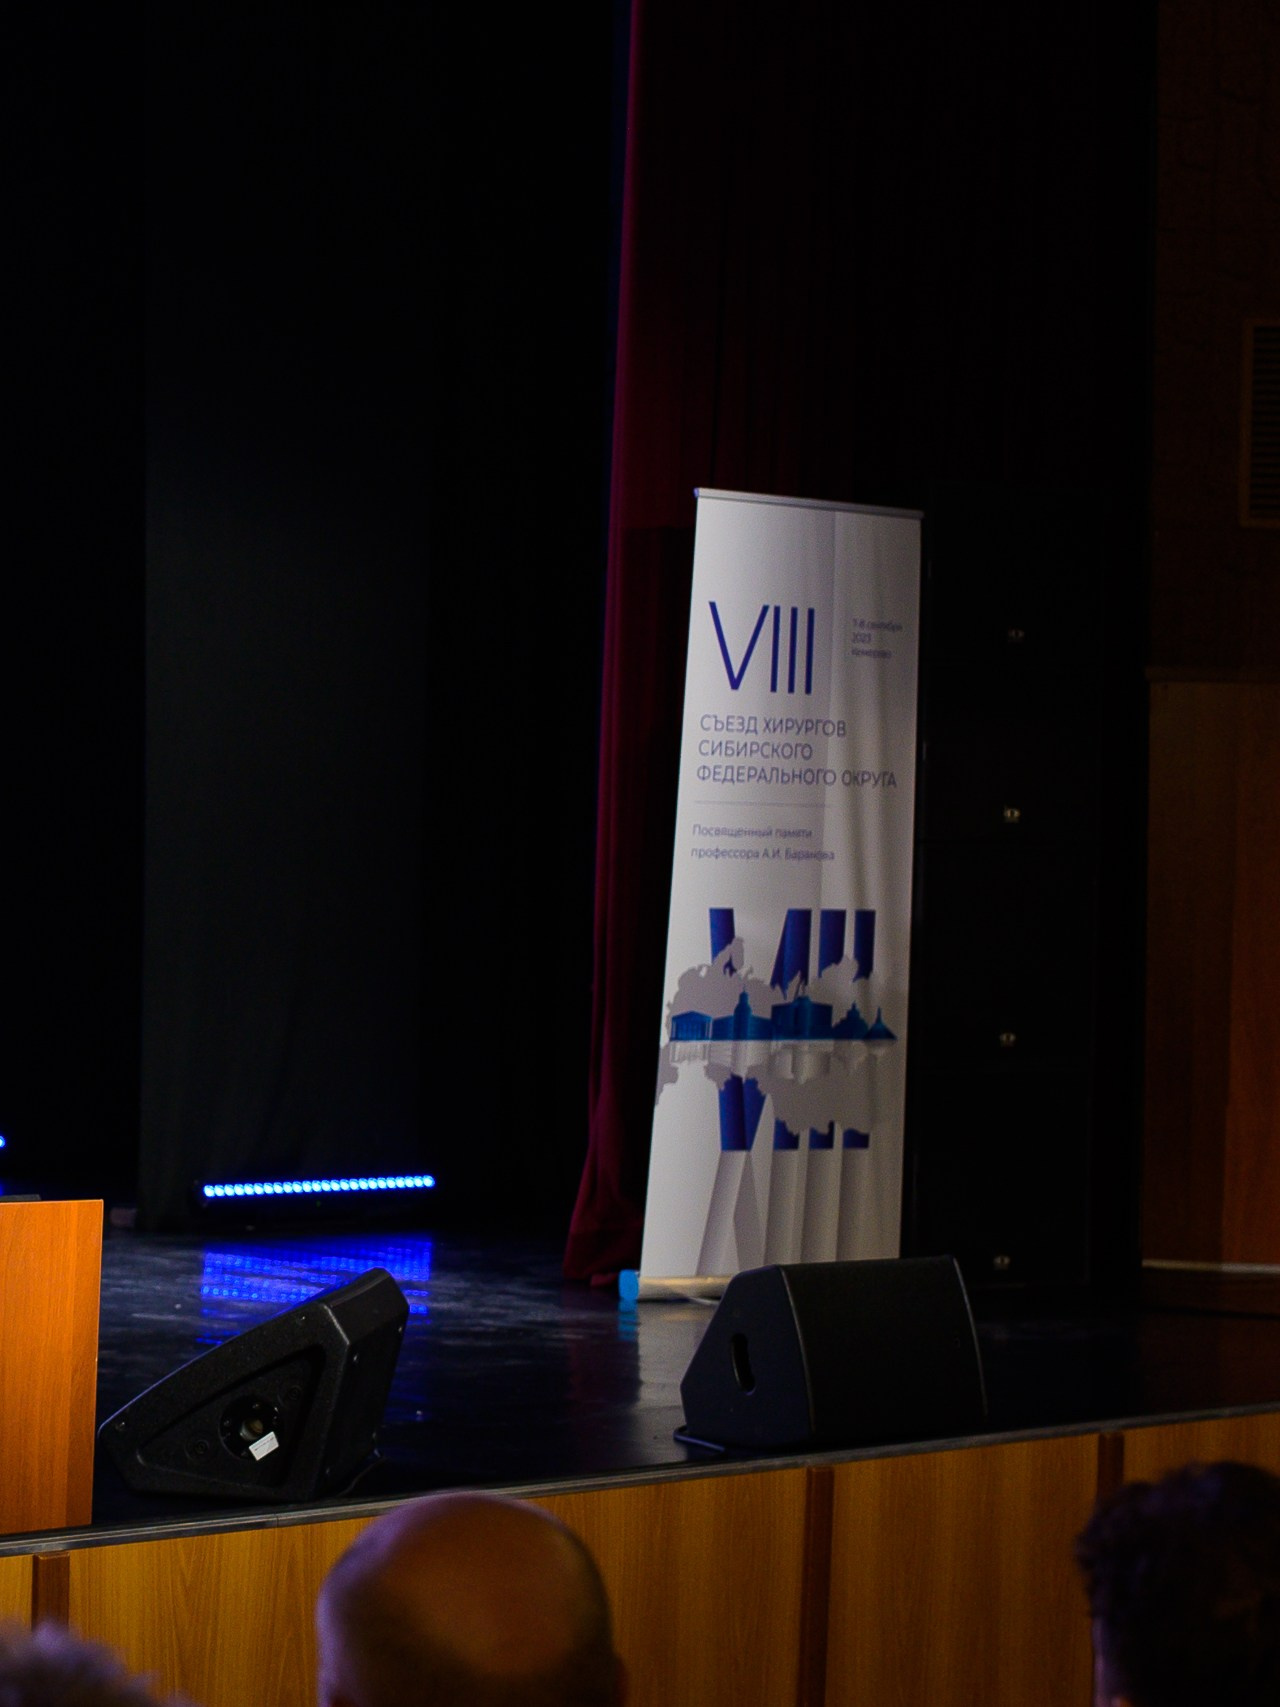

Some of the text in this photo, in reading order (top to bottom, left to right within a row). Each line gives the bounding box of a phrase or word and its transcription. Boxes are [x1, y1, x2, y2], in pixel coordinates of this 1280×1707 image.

[708, 601, 815, 695] VIII
[700, 714, 846, 738] СЪЕЗД ХИРУРГОВ
[698, 739, 813, 760] СИБИРСКОГО
[696, 765, 897, 788] ФЕДЕРАЛЬНОГО ОКРУГА
[690, 846, 760, 860] профессора
